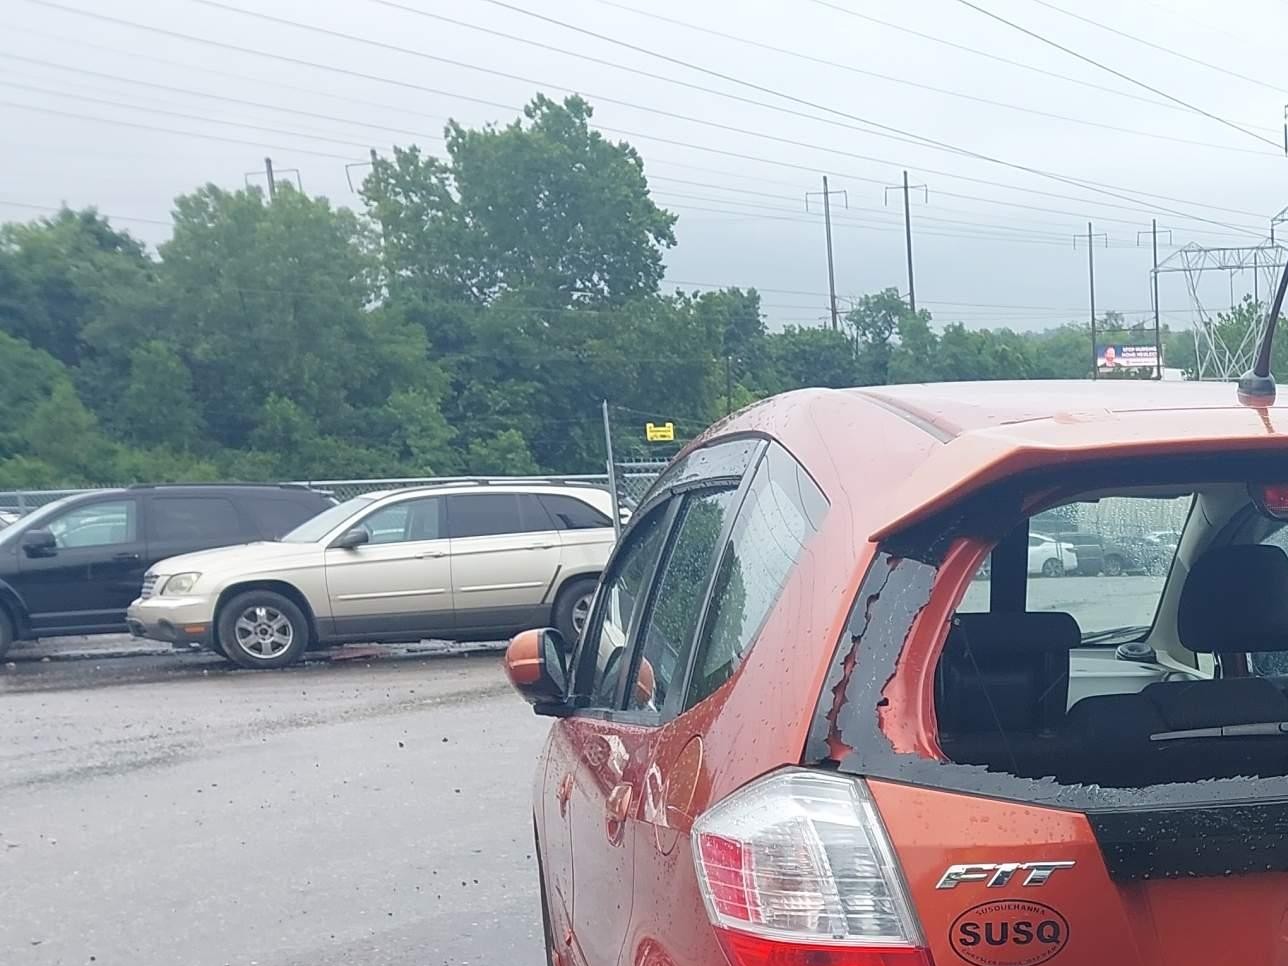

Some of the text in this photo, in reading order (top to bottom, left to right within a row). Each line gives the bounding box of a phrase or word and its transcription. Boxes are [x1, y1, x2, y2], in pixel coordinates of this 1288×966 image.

[935, 861, 1076, 889] FIT
[975, 903, 1046, 916] SUSQUEHANNA
[959, 920, 1061, 947] SUSQ
